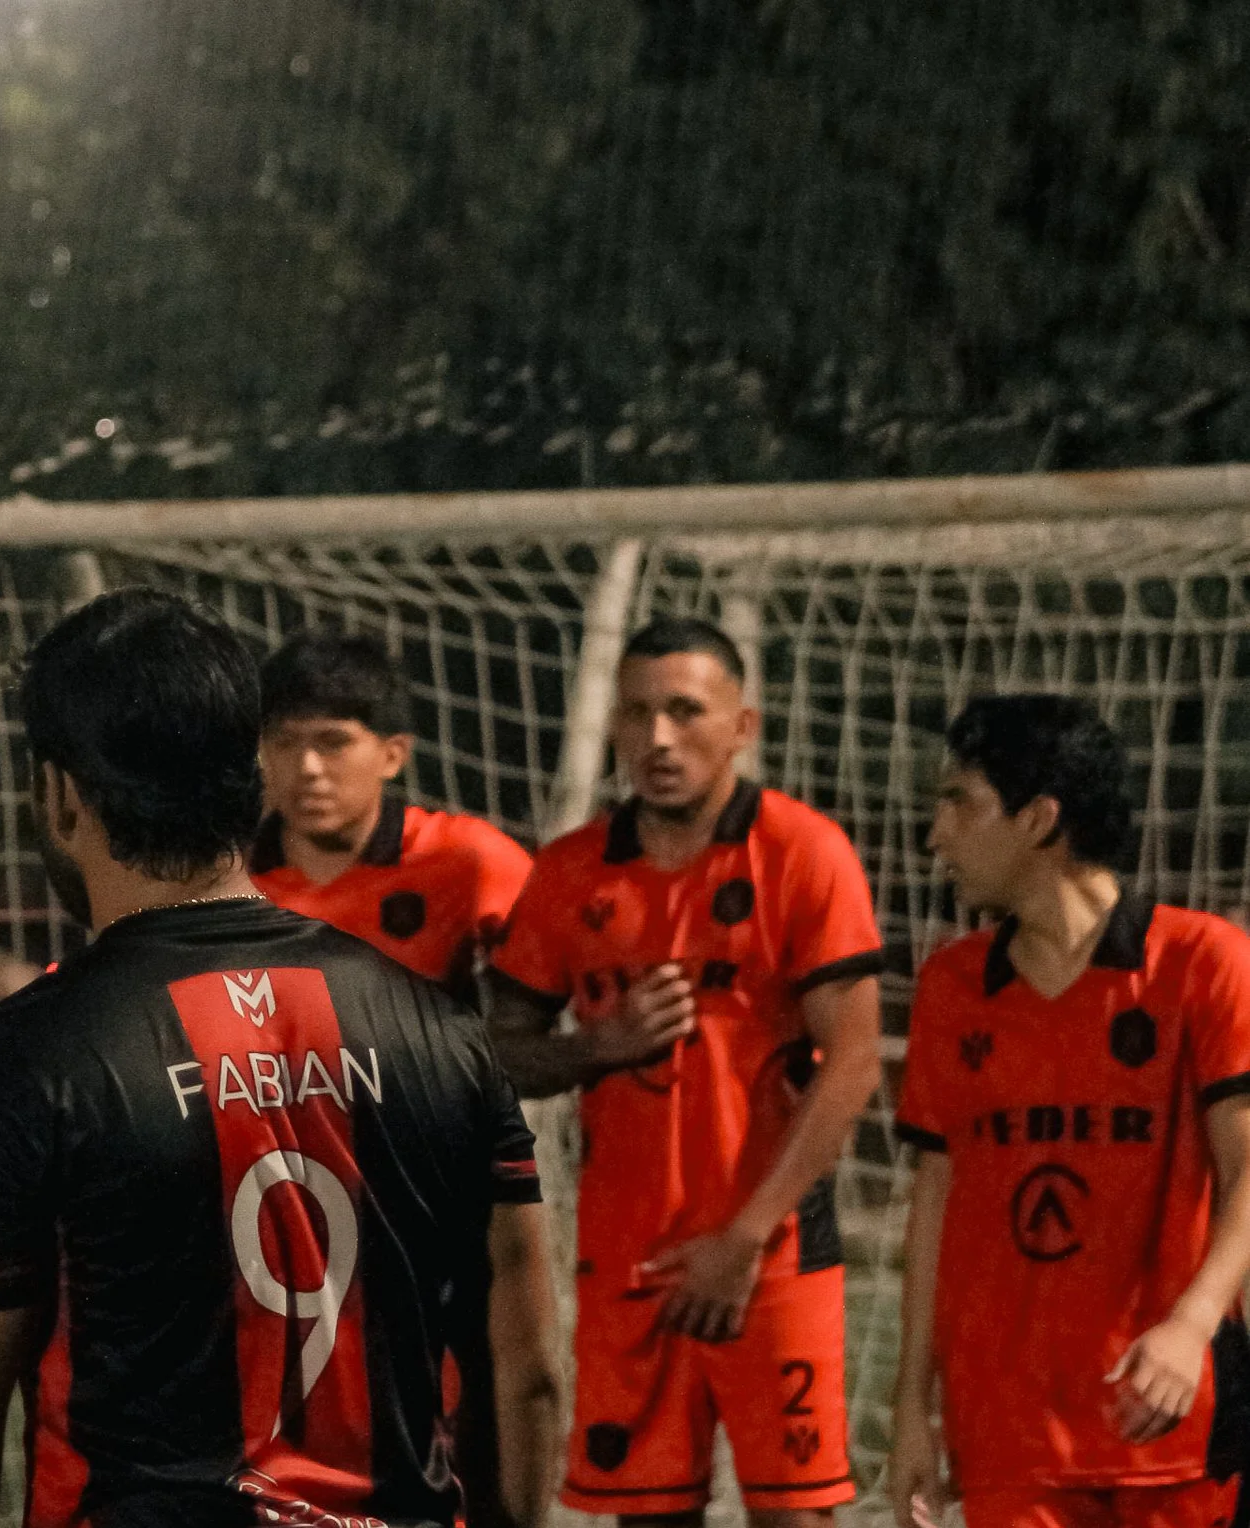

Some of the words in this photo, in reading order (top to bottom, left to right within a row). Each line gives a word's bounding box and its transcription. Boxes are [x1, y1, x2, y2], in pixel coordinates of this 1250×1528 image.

[166, 1047, 383, 1120] FABIAN
[231, 1149, 358, 1442] 9
[780, 1359, 815, 1416] 2
